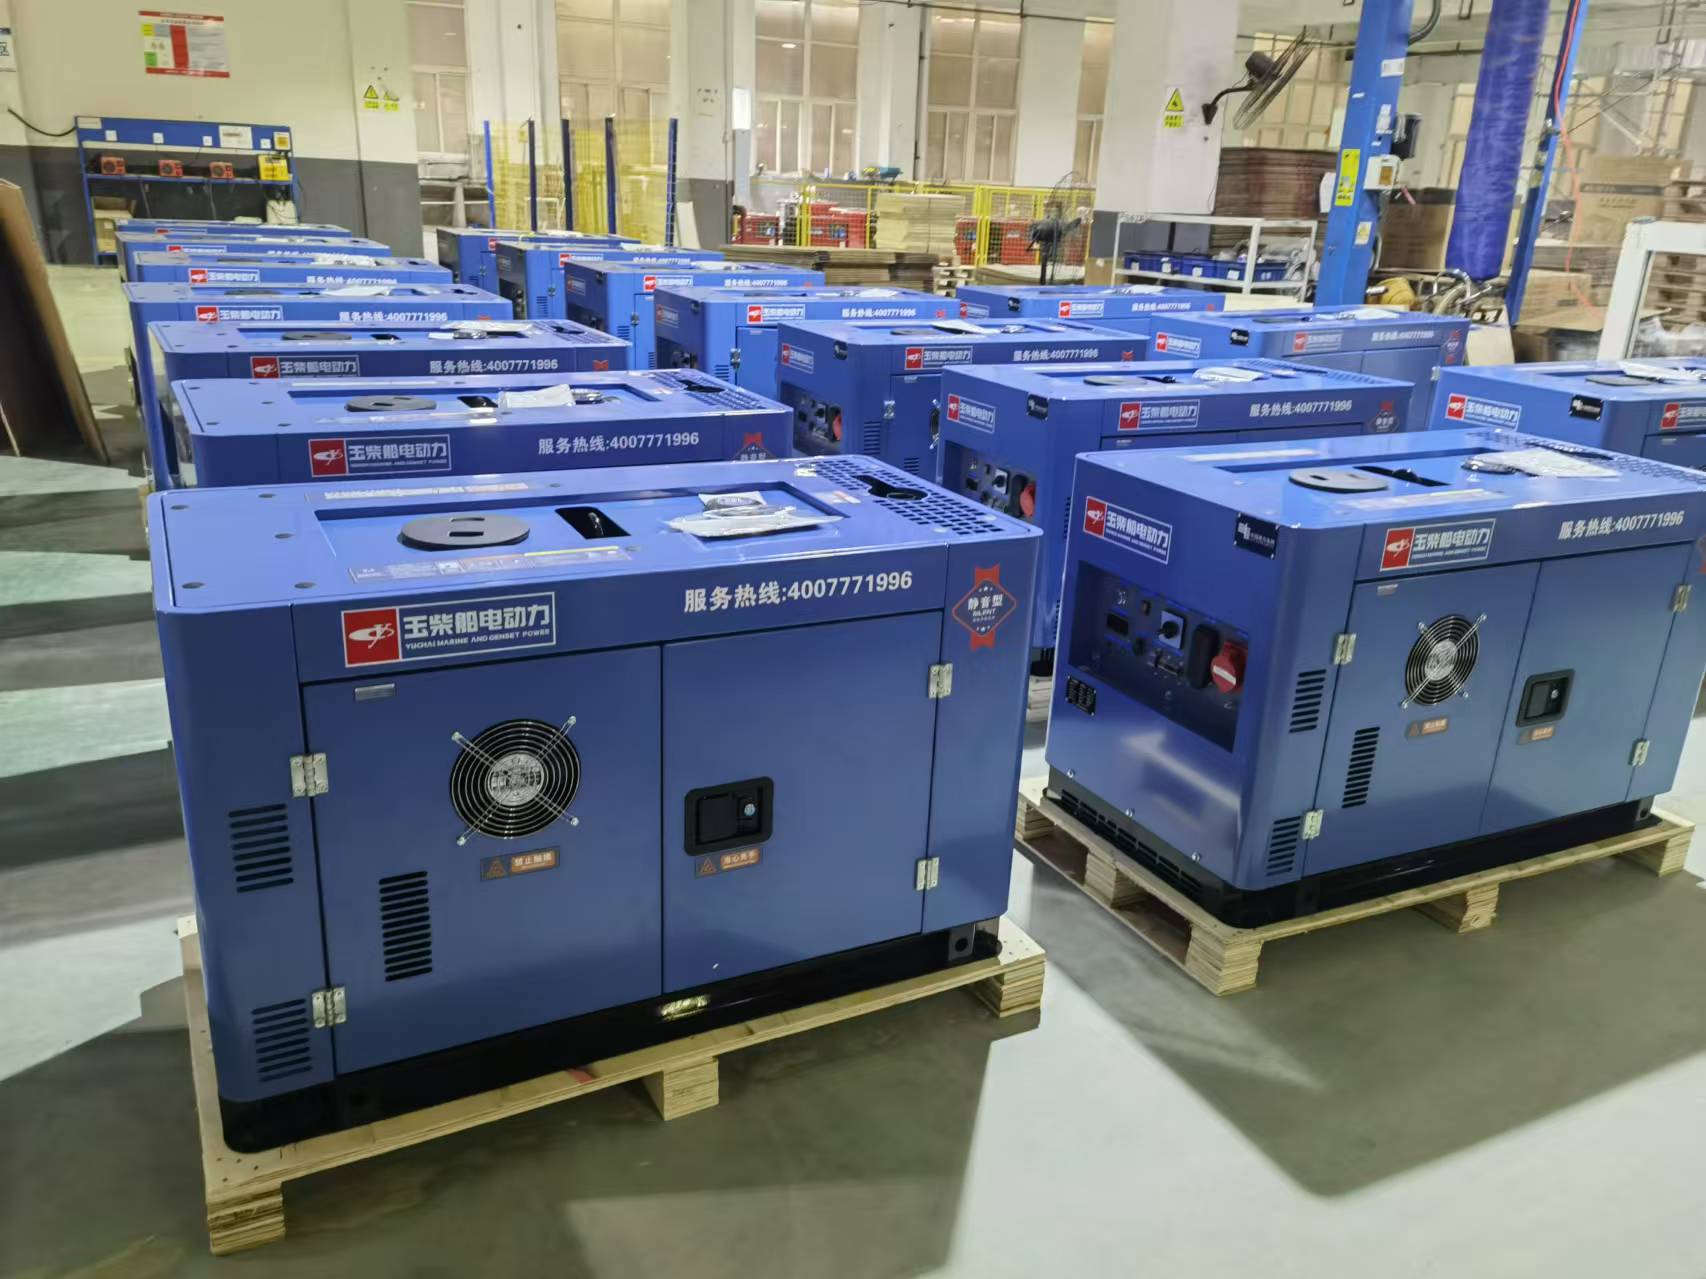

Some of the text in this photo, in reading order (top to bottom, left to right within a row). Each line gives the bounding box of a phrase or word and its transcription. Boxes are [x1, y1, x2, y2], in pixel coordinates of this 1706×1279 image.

[348, 442, 447, 461] 玉柴船电动力
[538, 431, 700, 455] 服务热线:4007771996
[1106, 510, 1169, 548] 玉柴船电动力
[1413, 528, 1491, 552] 玉柴船电动力
[1558, 510, 1686, 540] 服务热线:4007771996
[684, 571, 913, 613] 服务热线:4007771996
[403, 603, 550, 639] 玉柴船电动力
